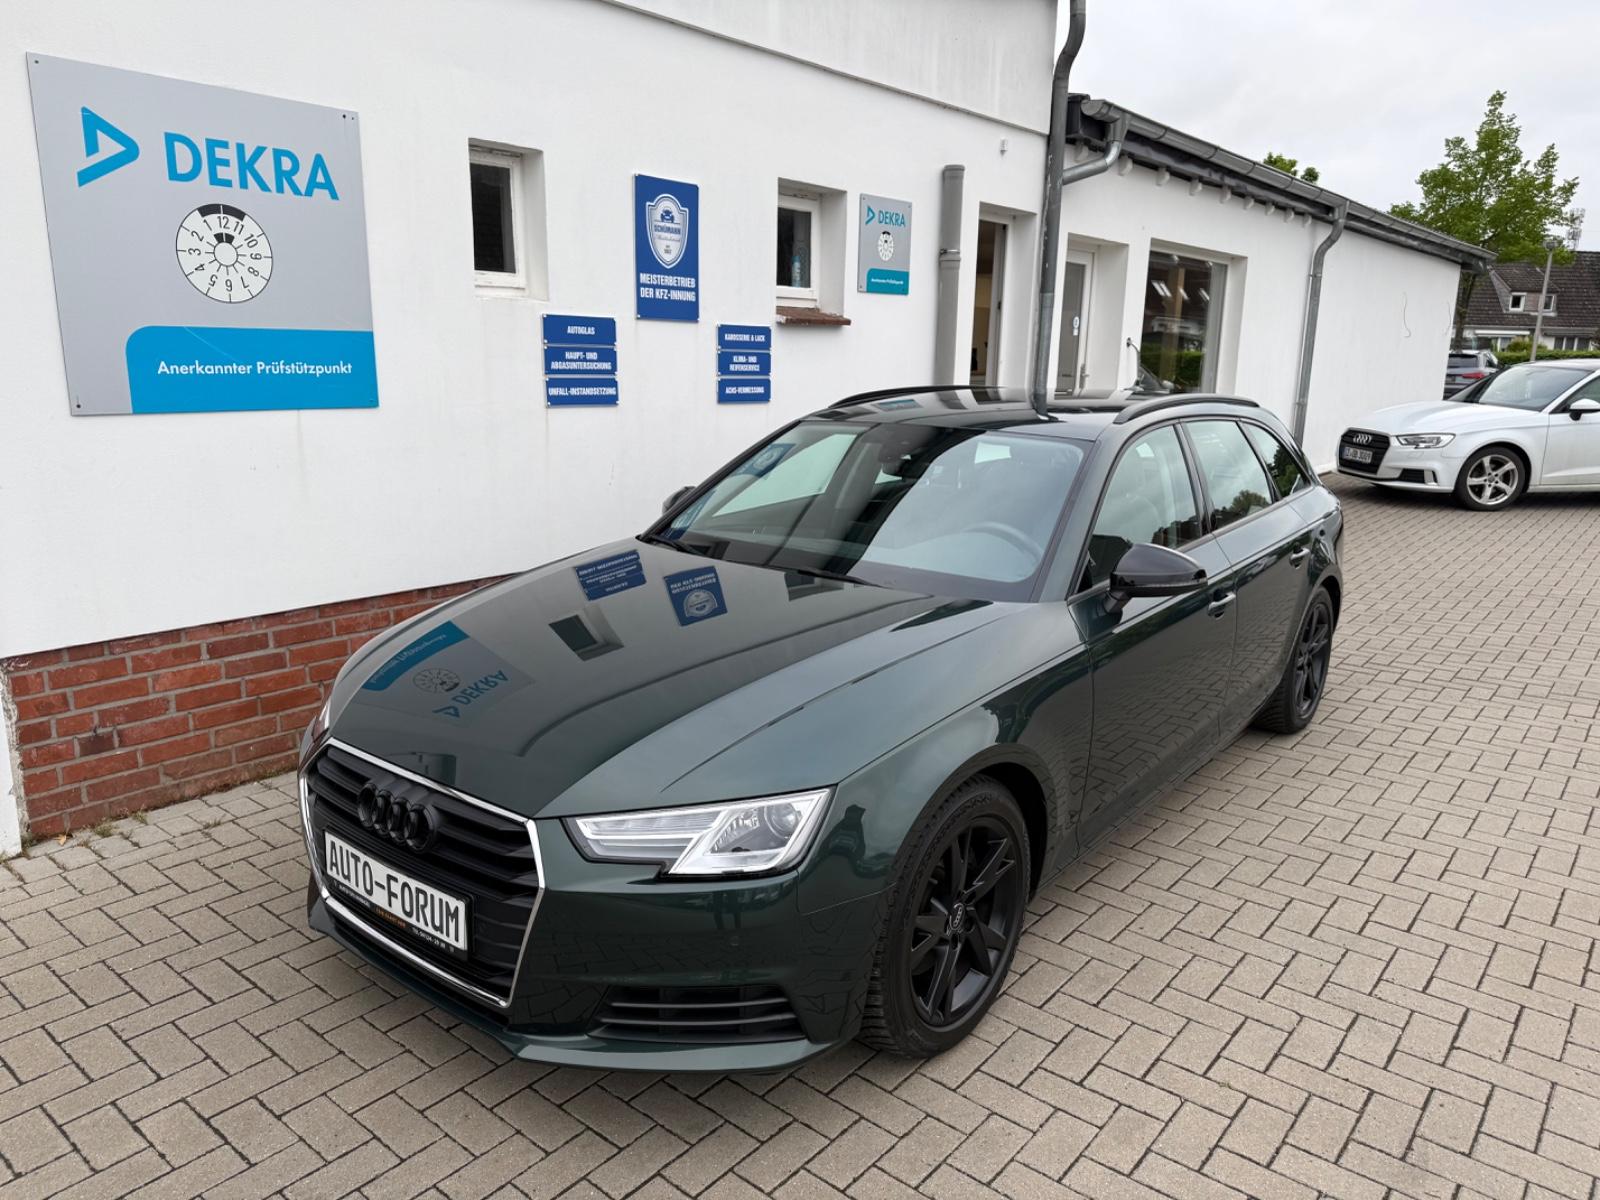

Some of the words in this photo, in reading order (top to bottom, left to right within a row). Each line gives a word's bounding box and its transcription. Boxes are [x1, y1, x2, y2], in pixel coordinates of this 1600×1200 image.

[164, 131, 339, 200] DEKRA
[202, 218, 212, 231] 1
[217, 215, 230, 229] 12
[878, 210, 905, 227] DEKRA
[233, 221, 245, 235] 11
[191, 230, 204, 242] 2
[244, 234, 258, 249] 10
[188, 248, 201, 256] 3
[250, 252, 262, 260] 9
[195, 263, 205, 272] 4
[247, 266, 259, 277] 8
[209, 274, 218, 287] 5
[225, 279, 232, 292] 6
[240, 275, 249, 289] 7
[640, 273, 696, 289] MEISTERBETRIEB
[640, 287, 654, 299] DER
[655, 289, 696, 302] KFZ-INNUNG
[567, 325, 595, 336] AUTOGLAS
[586, 352, 598, 360] UND
[157, 360, 253, 376] Anerkannter
[256, 360, 353, 379] Prüfstützpunkt
[329, 840, 459, 943] AUTO-FORUM
